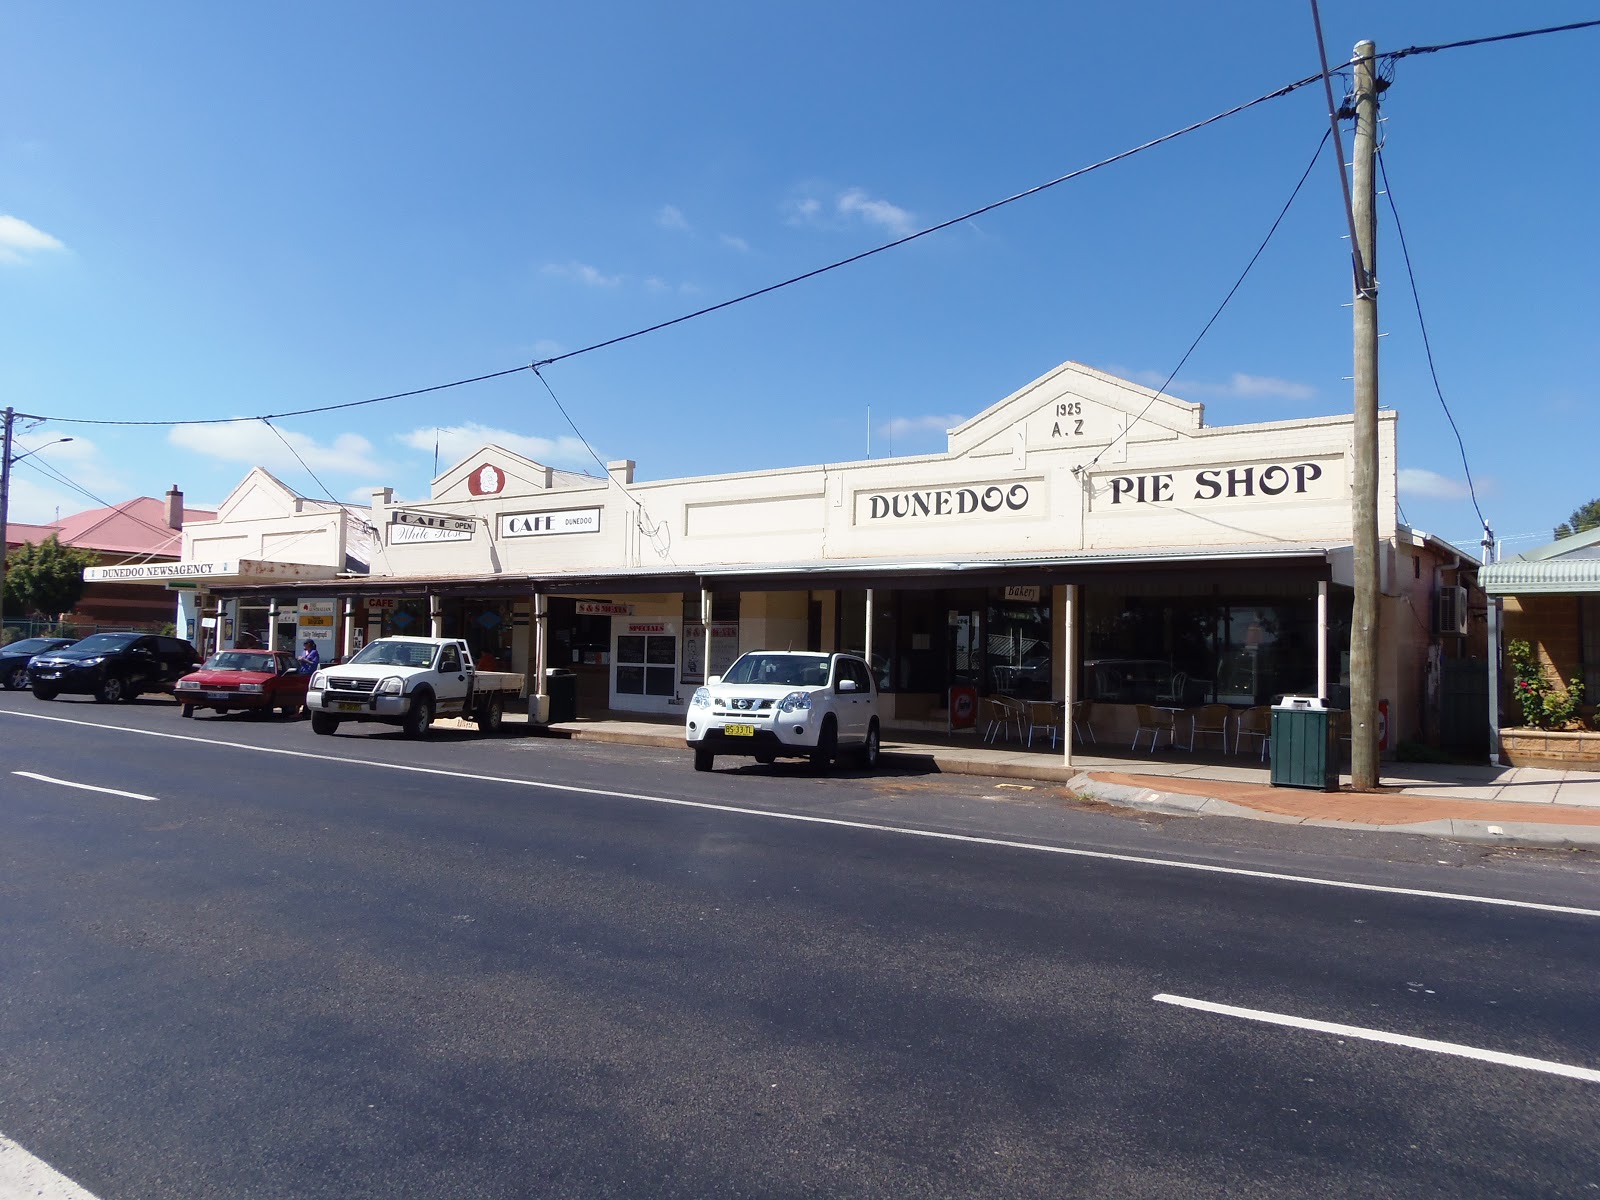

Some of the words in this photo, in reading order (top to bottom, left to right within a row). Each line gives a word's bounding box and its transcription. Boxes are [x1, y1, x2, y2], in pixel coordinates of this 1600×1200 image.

[1056, 402, 1082, 417] 1925
[870, 484, 1030, 519] DUNEDOO
[1110, 474, 1175, 505] PIE
[1193, 463, 1322, 500] SHOP
[400, 514, 450, 529] CAFE
[454, 521, 472, 530] OPEN
[509, 515, 556, 533] CAFE
[564, 517, 592, 526] DUNEDOO
[397, 526, 429, 540] White
[102, 567, 144, 578] DUNEDOO
[146, 563, 213, 577] NEWSAGENCY
[1008, 585, 1035, 600] Bakery
[368, 599, 394, 608] CAFE
[629, 624, 664, 632] SPECIALS
